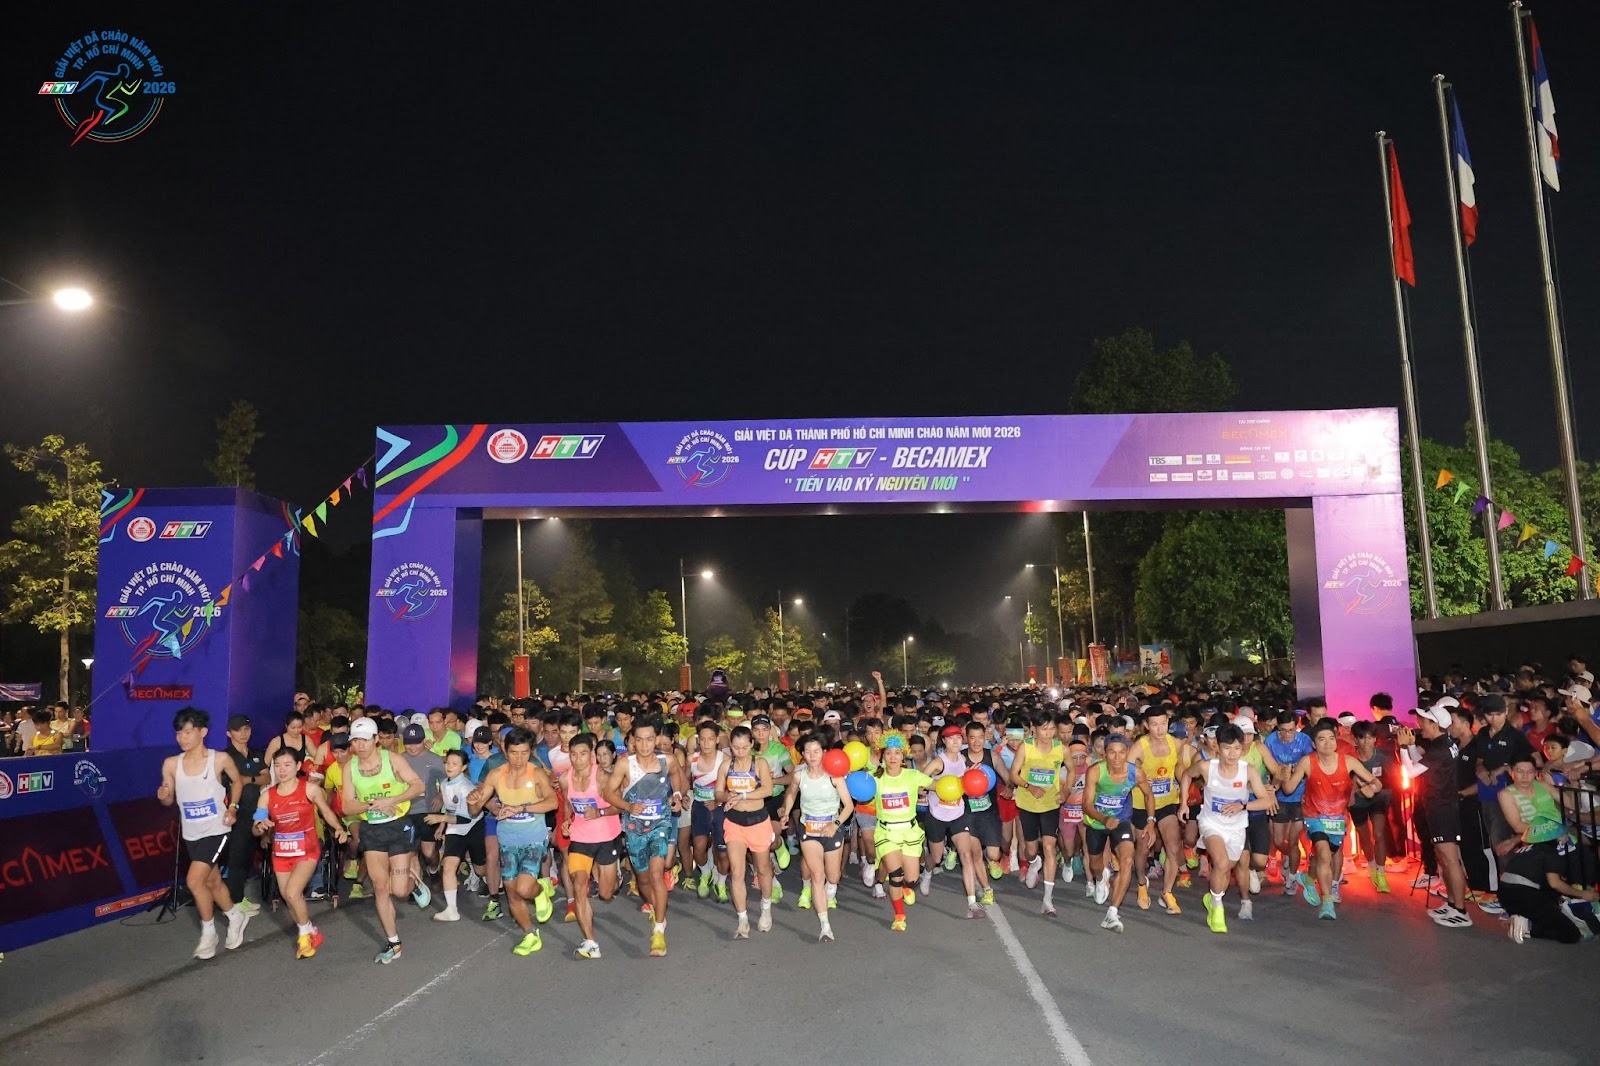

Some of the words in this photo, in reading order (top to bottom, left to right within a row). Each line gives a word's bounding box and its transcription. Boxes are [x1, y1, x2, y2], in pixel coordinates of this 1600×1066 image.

[734, 428, 753, 441] GIẢI
[756, 428, 776, 442] VIỆT
[780, 428, 792, 440] DÃ
[795, 427, 827, 440] THÀNH
[831, 426, 850, 440] PHỐ
[869, 426, 885, 439] CHÍ
[888, 427, 914, 438] MINH
[917, 426, 942, 438] CHÀO
[946, 426, 969, 438] NĂM
[994, 426, 1021, 438] 2026
[536, 436, 601, 456] HTV
[764, 444, 808, 470] CÚP
[811, 450, 874, 468] HTV
[891, 446, 992, 468] BECAMEX
[795, 474, 824, 492] TIẾN
[826, 474, 852, 491] VÀO
[854, 473, 874, 491] KỶ
[875, 474, 929, 491] NGUYÊN
[161, 523, 210, 537] HTV
[176, 577, 195, 596] MINH
[106, 607, 138, 617] HTV
[18, 773, 52, 792] HTV
[280, 841, 298, 850] 5019
